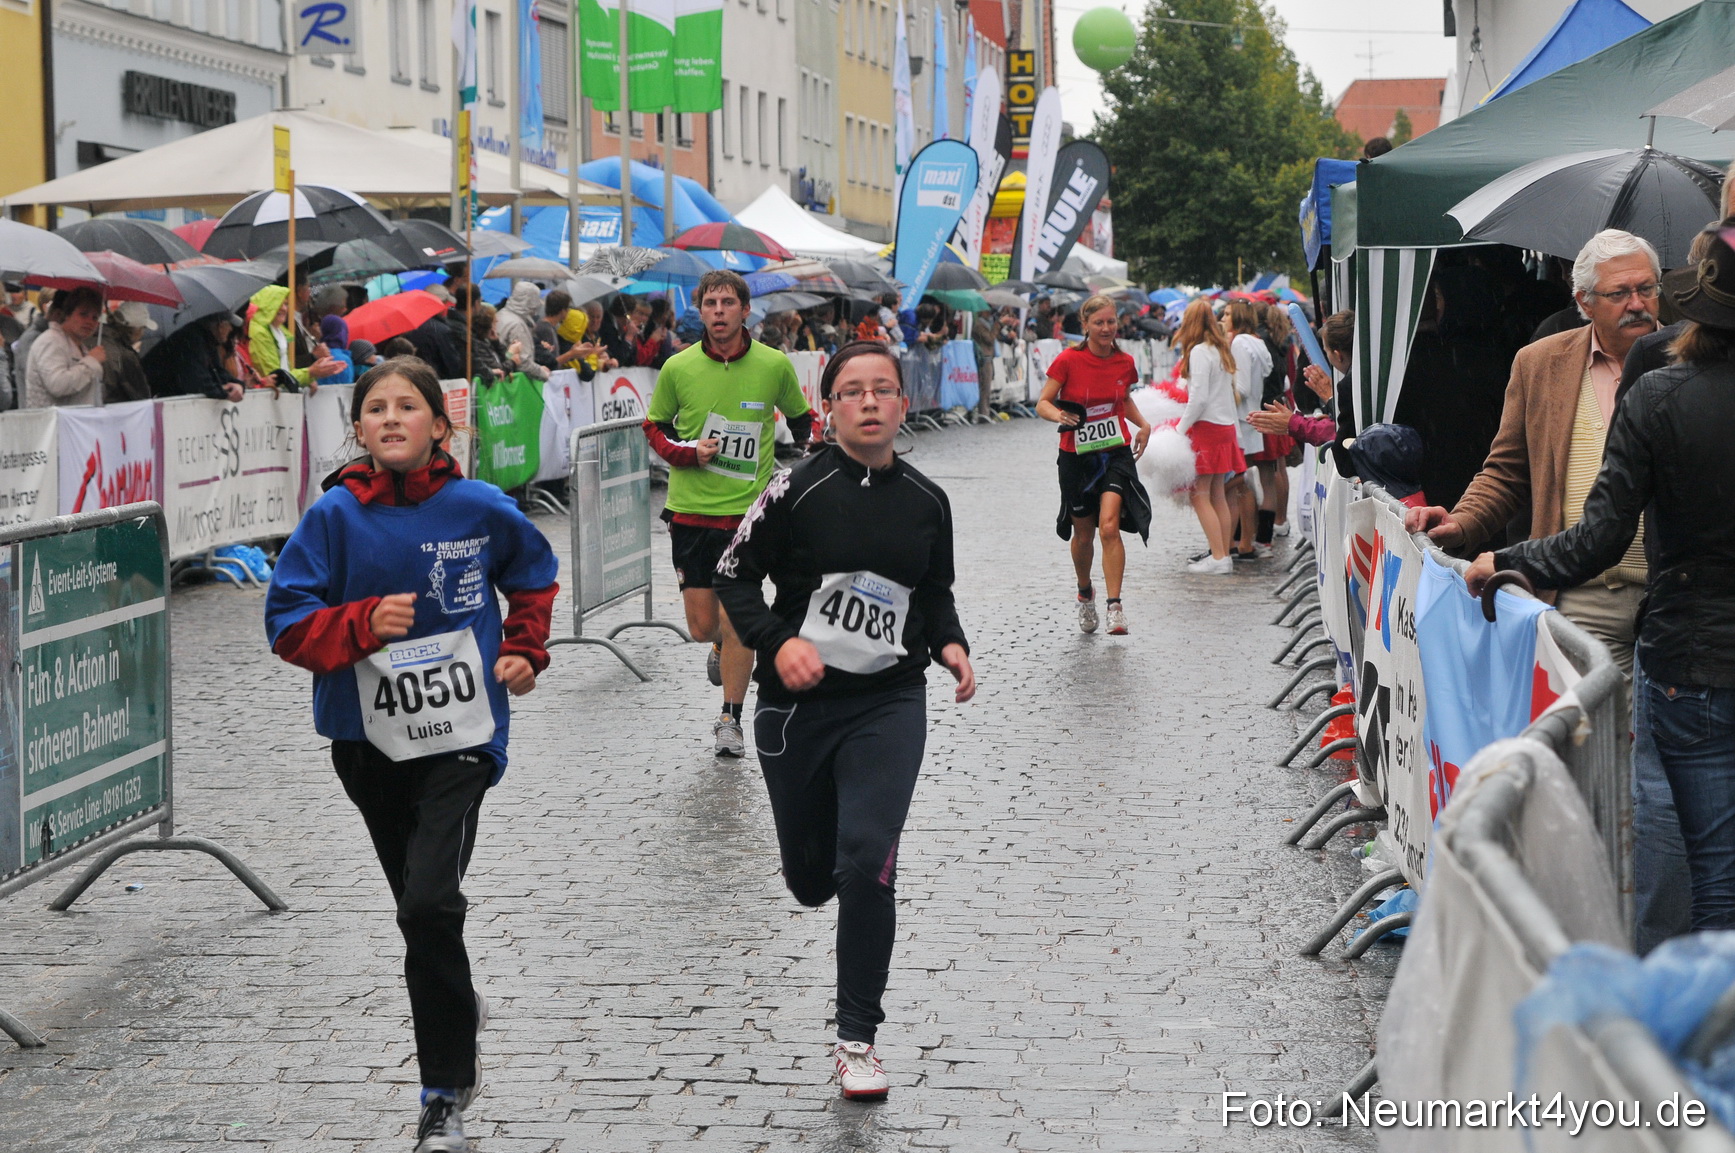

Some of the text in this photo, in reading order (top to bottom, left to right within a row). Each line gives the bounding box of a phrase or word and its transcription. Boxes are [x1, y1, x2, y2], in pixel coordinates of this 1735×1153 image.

[923, 168, 962, 186] maxi
[942, 194, 956, 207] dsl
[1078, 420, 1117, 443] 5200
[421, 536, 490, 553] 12. NEUMARKTER
[436, 546, 481, 560] STADTLAUF
[48, 560, 117, 595] Event-Leit-Systeme
[819, 589, 896, 647] 4088
[389, 642, 442, 663] BOCK
[28, 640, 119, 708] Fun & Action in
[374, 661, 476, 717] 4050
[28, 696, 129, 775] sicheren Bahnen!
[407, 721, 453, 740] Luisa
[49, 813, 57, 840] &
[58, 803, 84, 837] Service
[85, 796, 102, 824] Line:
[103, 783, 123, 815] 09181
[125, 775, 142, 805] 6352
